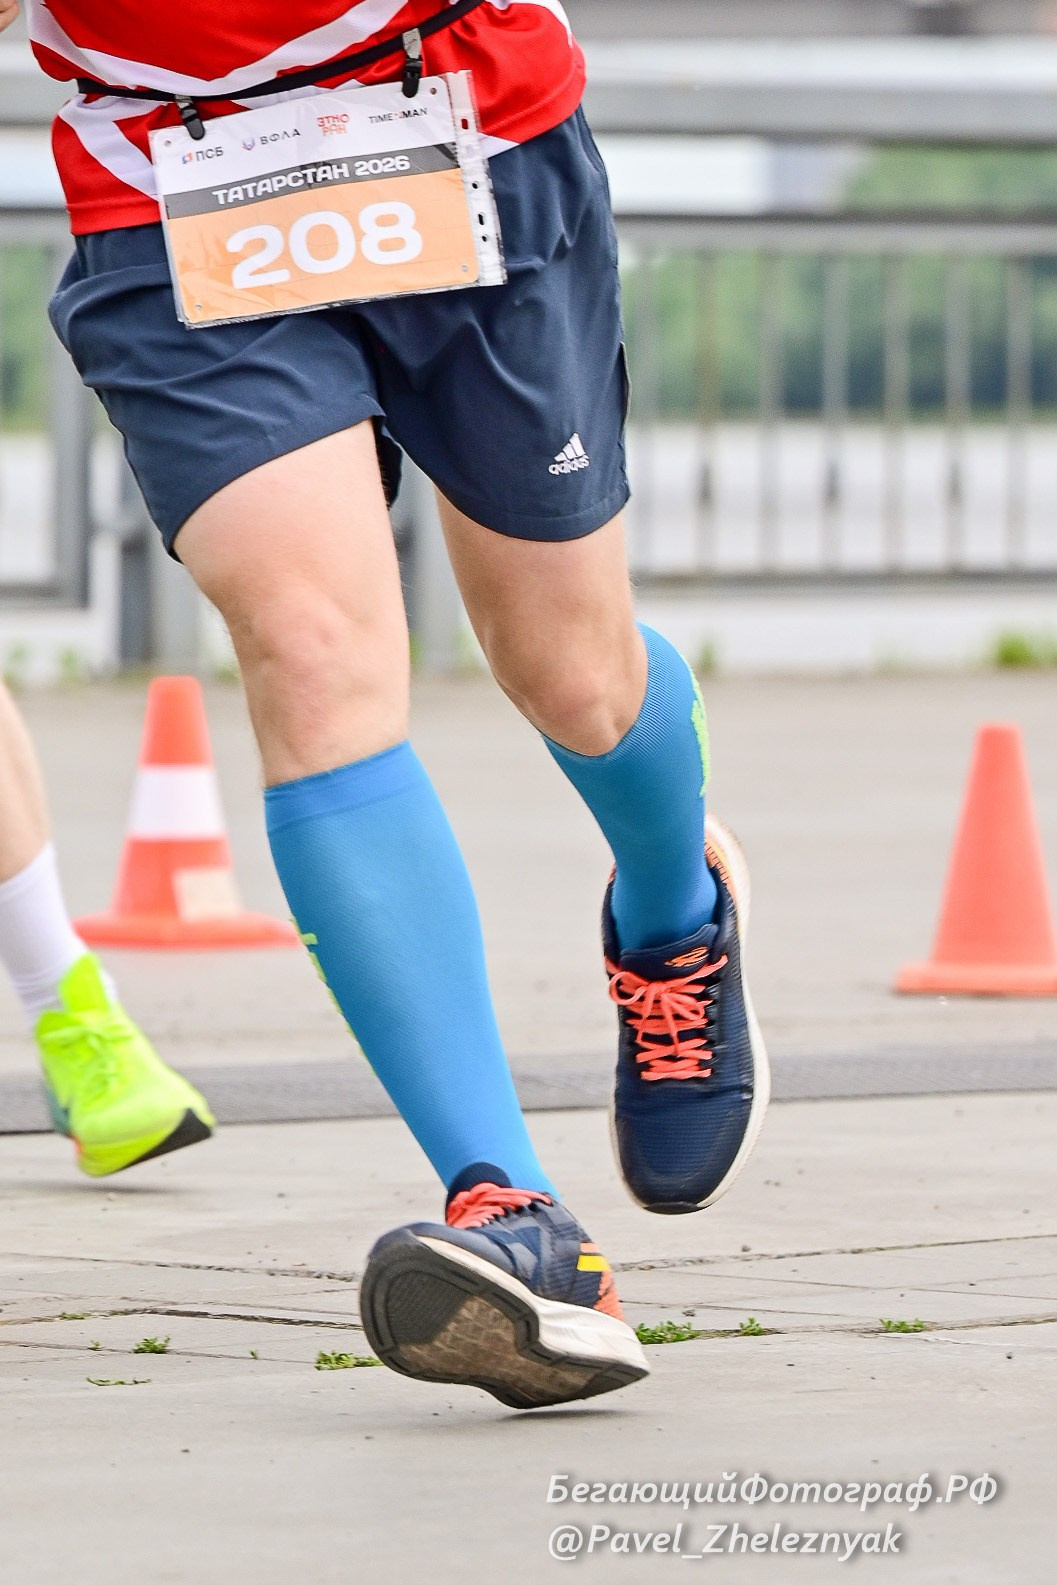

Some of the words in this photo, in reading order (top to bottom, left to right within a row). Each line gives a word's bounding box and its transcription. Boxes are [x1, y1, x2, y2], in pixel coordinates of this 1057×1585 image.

[260, 128, 302, 145] ВФЛА
[195, 146, 224, 162] ПСБ
[211, 163, 350, 206] ТАТАРСТАН
[354, 155, 411, 176] 2026
[225, 201, 424, 290] 208
[548, 455, 590, 475] adidas
